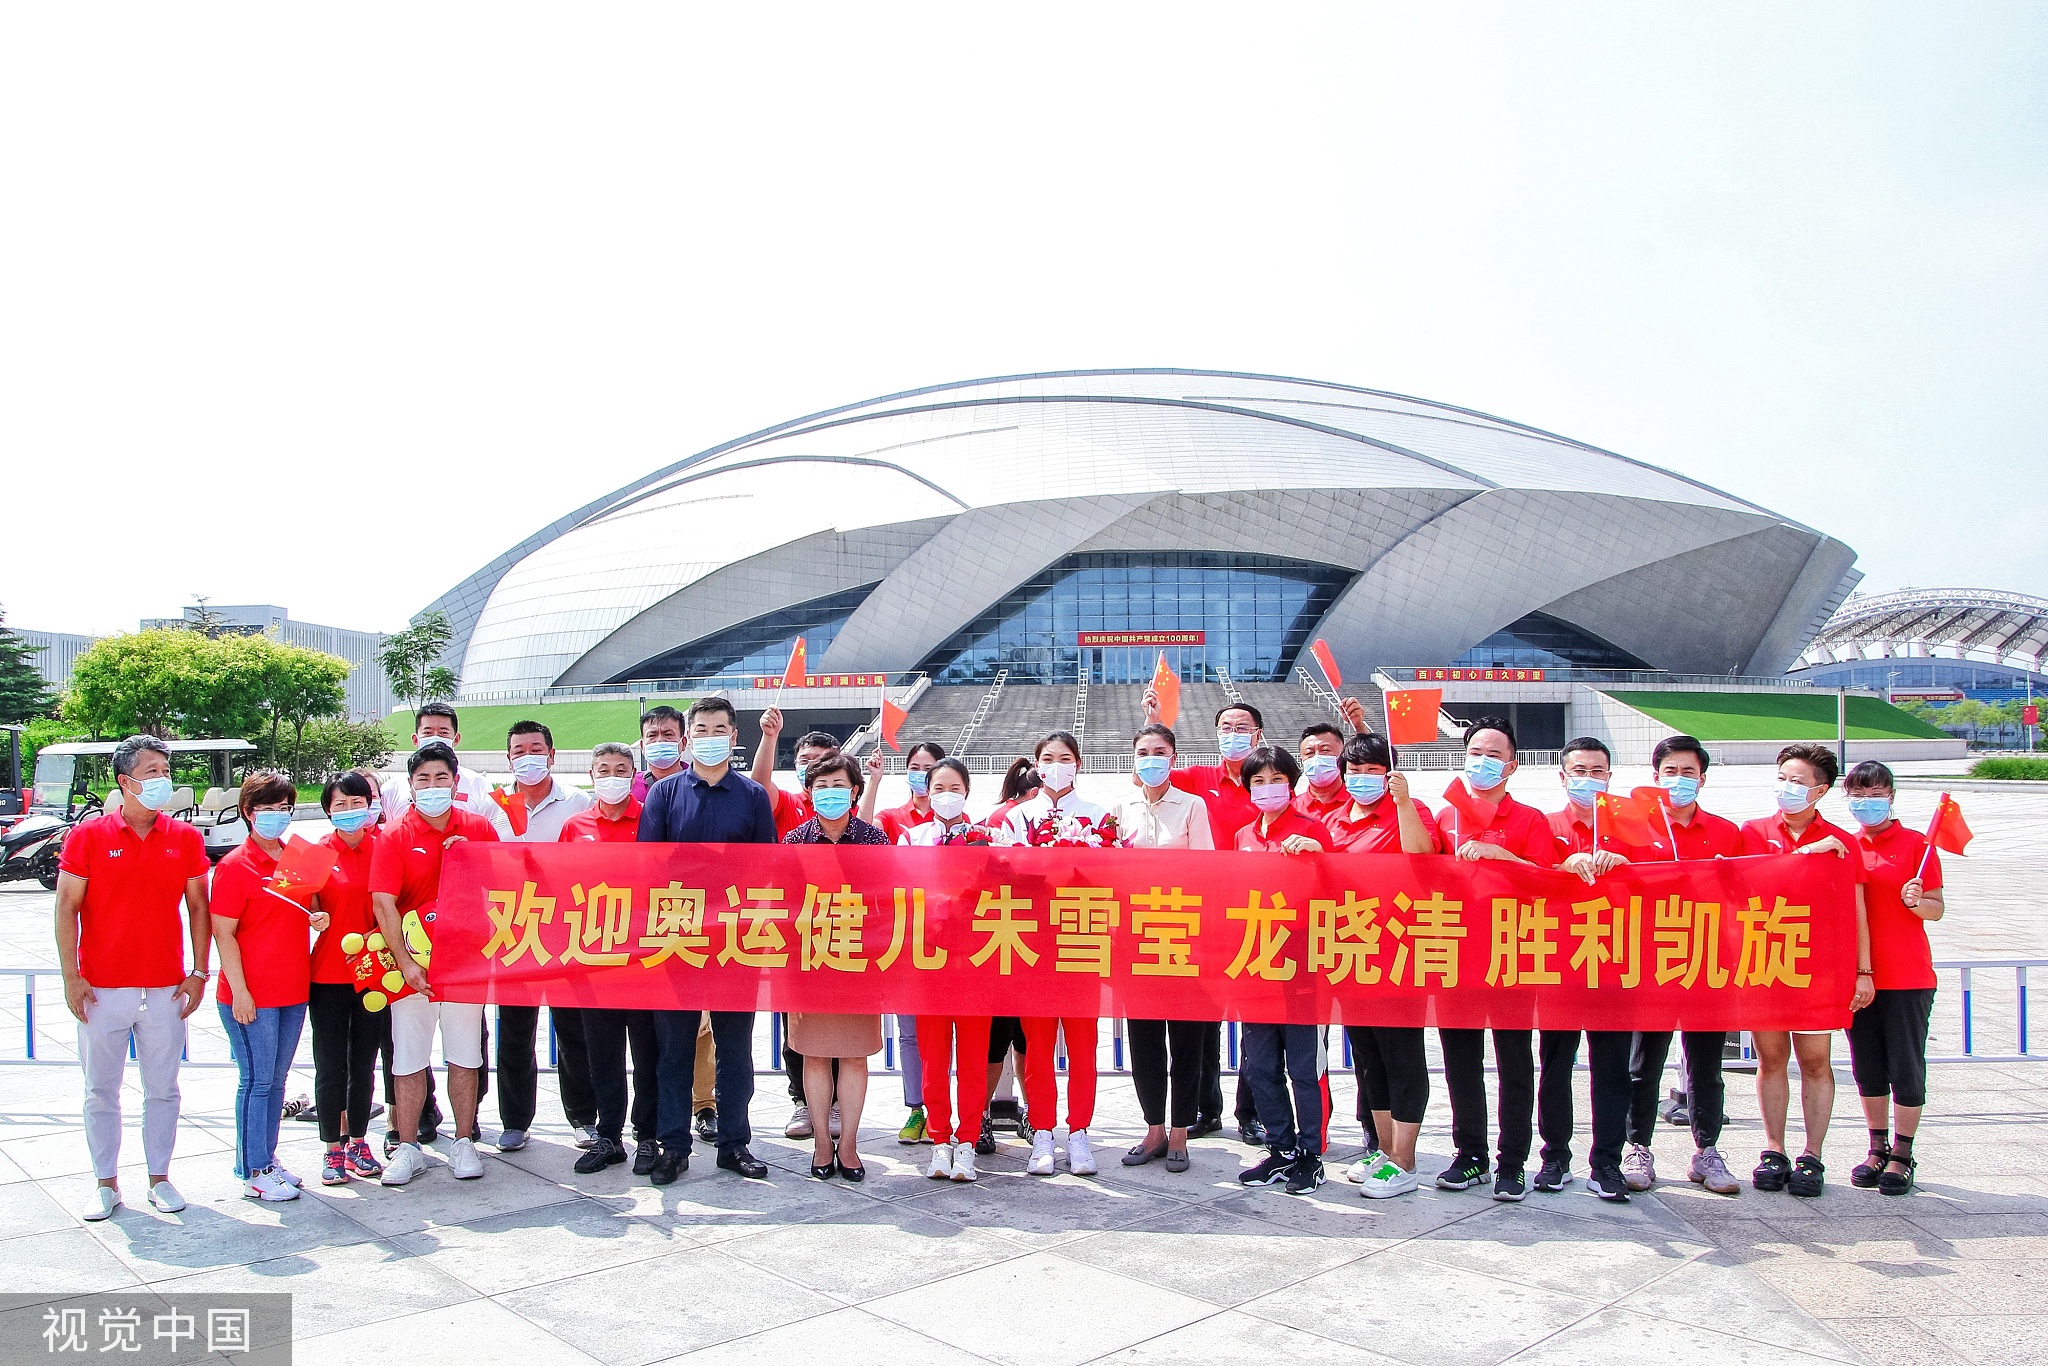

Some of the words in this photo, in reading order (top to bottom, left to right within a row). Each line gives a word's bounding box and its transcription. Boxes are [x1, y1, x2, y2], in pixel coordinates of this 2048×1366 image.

[756, 675, 884, 688] 百年程波澜壮阔
[1418, 670, 1541, 680] 百年初心历久弥坚
[480, 881, 948, 972] 欢迎奥运健儿
[968, 884, 1203, 978] 朱雪莹
[1224, 889, 1468, 988] 龙晓清
[1484, 895, 1812, 990] 胜利凯旋
